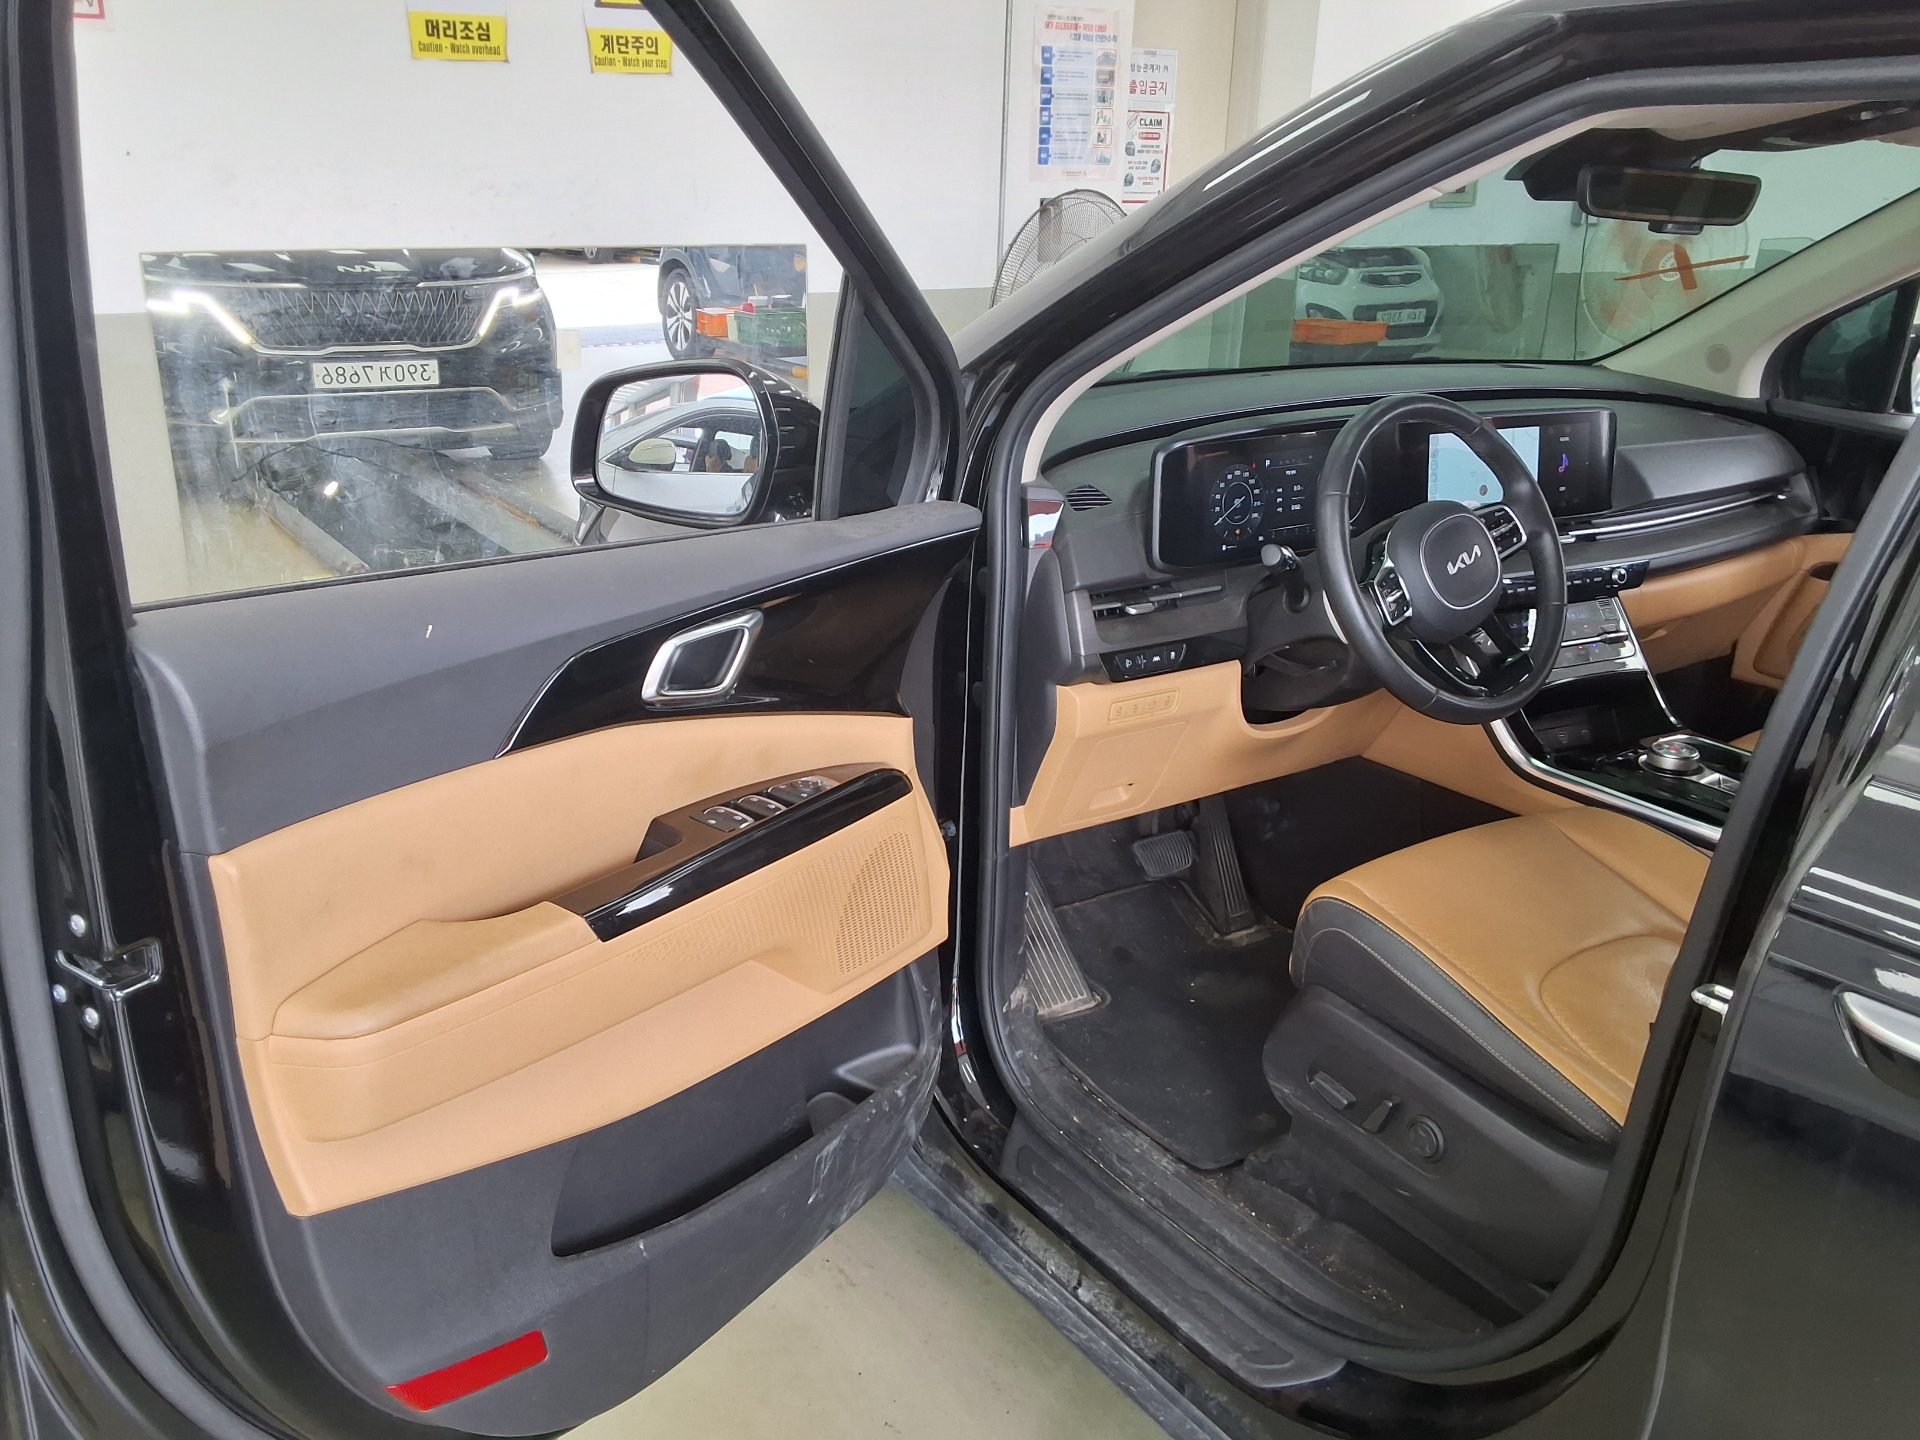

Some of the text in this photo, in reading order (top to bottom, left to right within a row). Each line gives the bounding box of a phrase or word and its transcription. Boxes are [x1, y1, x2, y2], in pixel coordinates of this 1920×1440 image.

[425, 19, 491, 41] 머리조심
[418, 41, 443, 53] Caution
[450, 43, 470, 54] Watch
[472, 44, 501, 55] overhead
[600, 34, 659, 55] 계단주의
[594, 55, 616, 67] Caution
[622, 56, 640, 68] Watch
[642, 58, 654, 68] your
[655, 58, 668, 69] step
[1129, 79, 1168, 95] 출입금지
[1140, 118, 1162, 127] CLAIM
